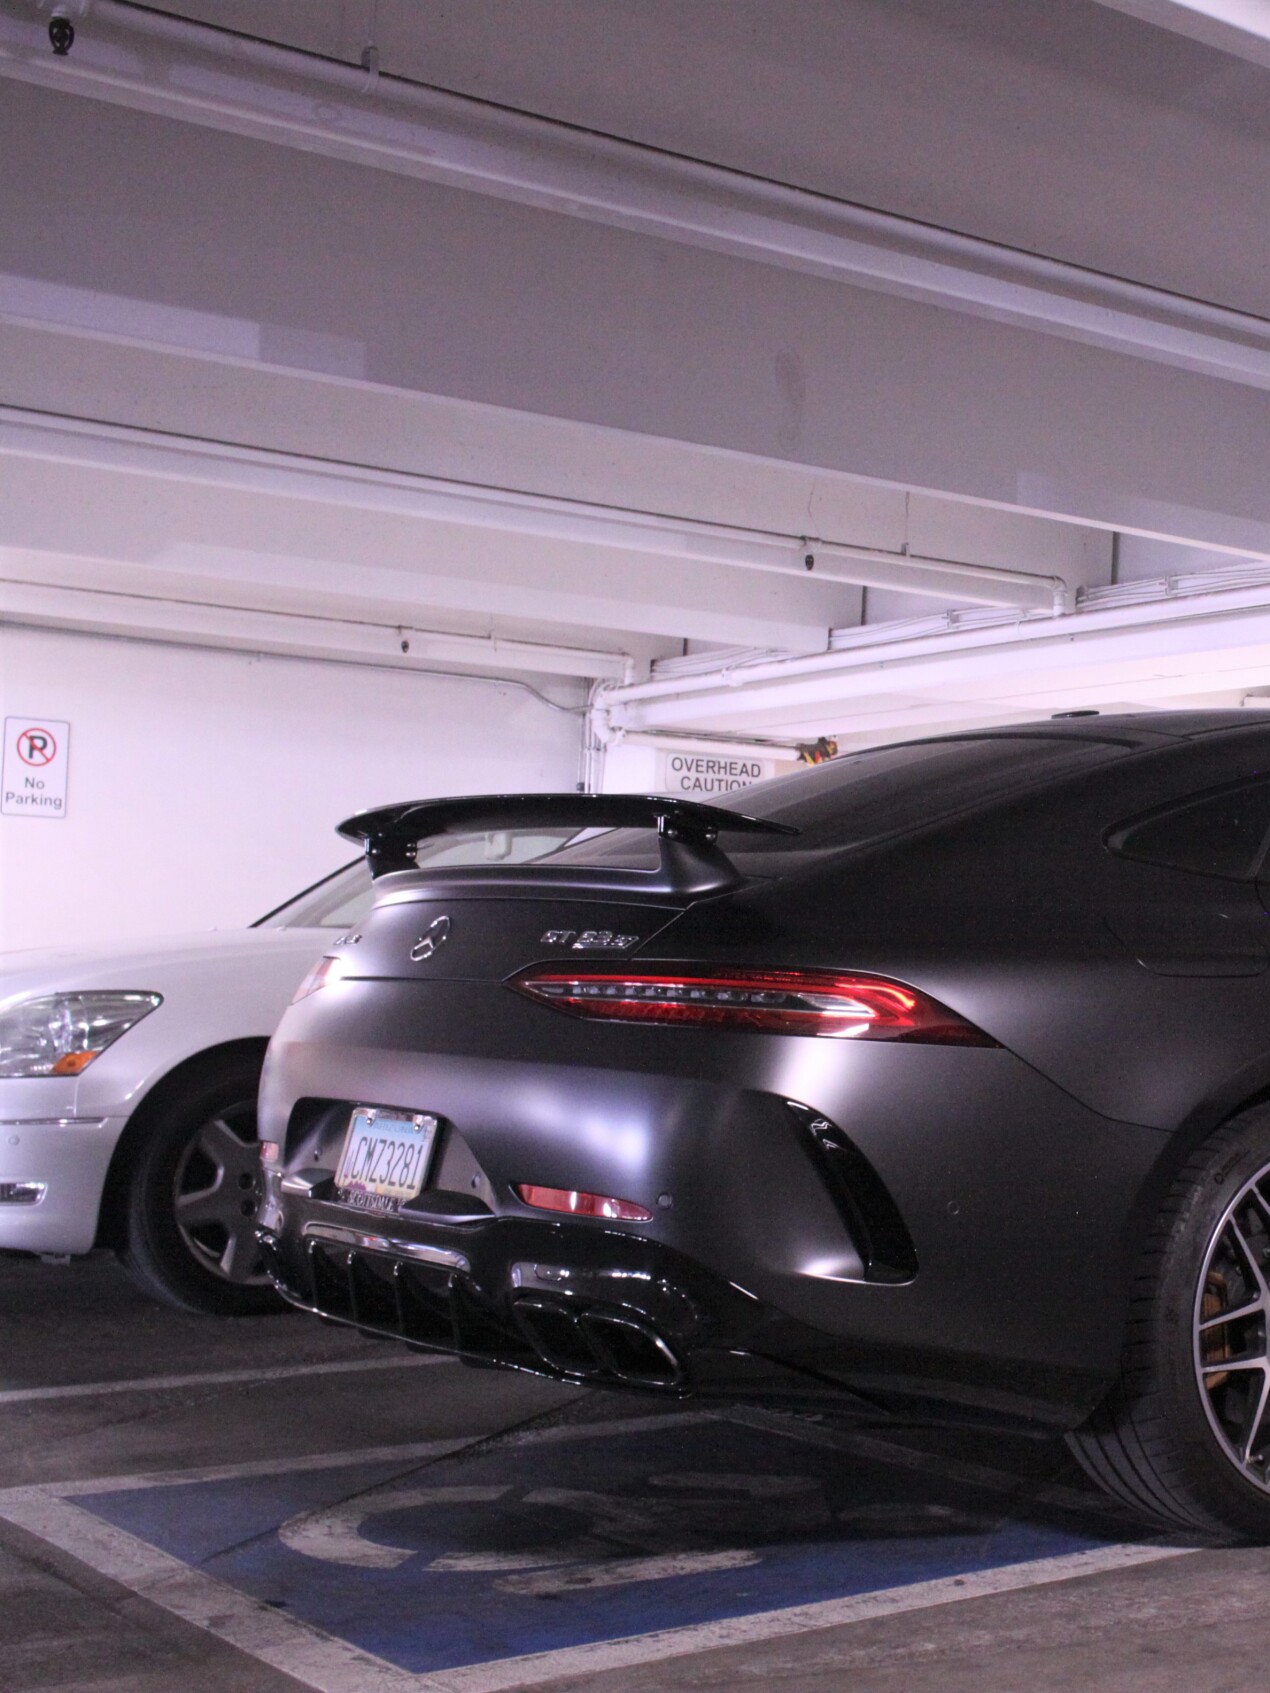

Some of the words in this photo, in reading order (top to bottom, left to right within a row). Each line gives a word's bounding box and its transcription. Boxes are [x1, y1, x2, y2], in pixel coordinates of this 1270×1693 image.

[671, 757, 761, 778] OVERHEAD
[24, 776, 45, 790] No
[5, 791, 63, 811] Parking
[541, 930, 576, 943] GT
[351, 1136, 423, 1190] CMZ3281
